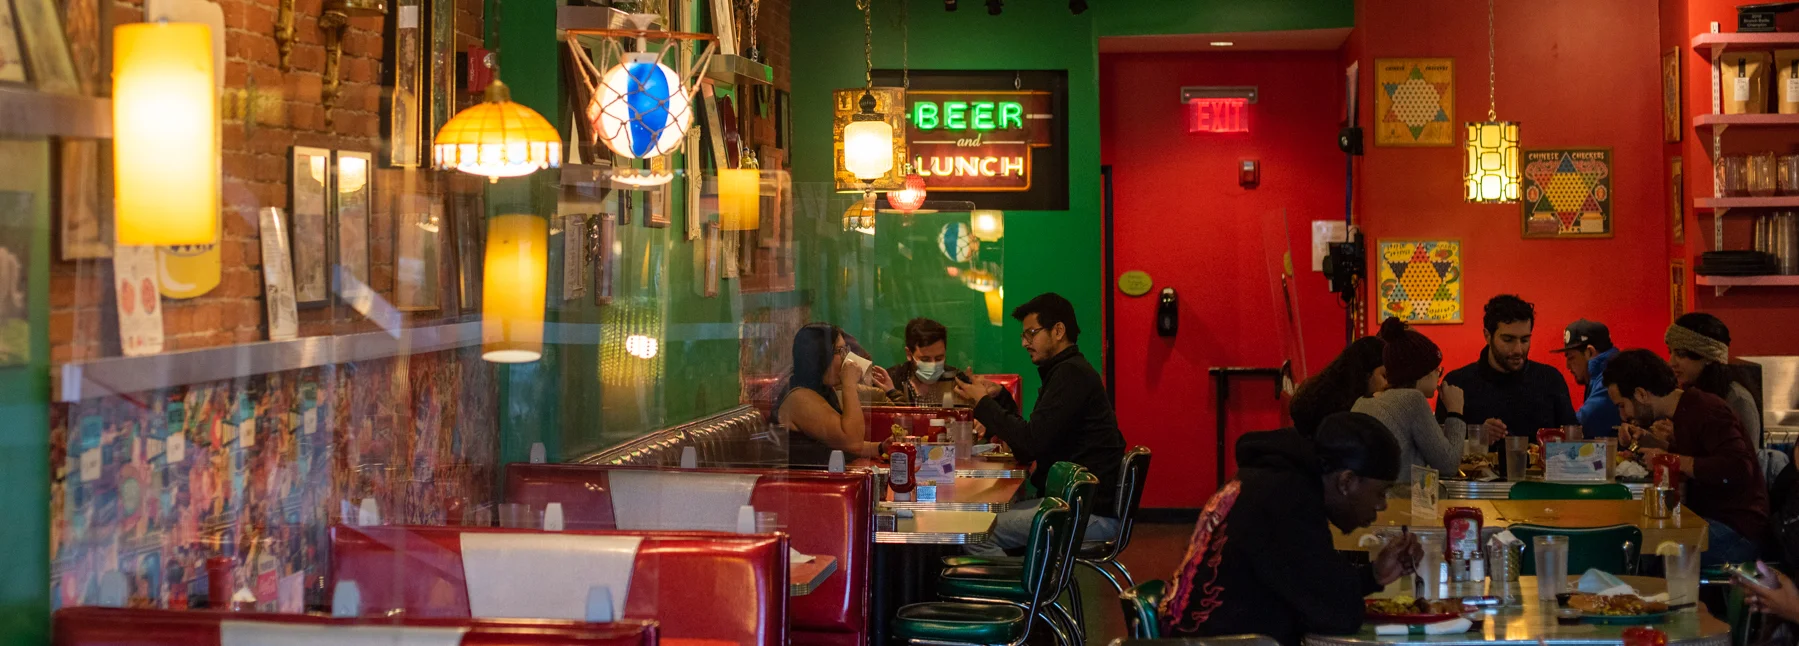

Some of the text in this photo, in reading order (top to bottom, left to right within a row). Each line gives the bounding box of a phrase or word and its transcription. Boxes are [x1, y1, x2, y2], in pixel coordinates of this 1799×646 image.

[914, 101, 1023, 130] BEER
[1197, 101, 1244, 131] EXIT
[957, 133, 982, 147] and
[915, 155, 1024, 177] LUNCH
[1528, 151, 1605, 161] CHINESE CHECKERS
